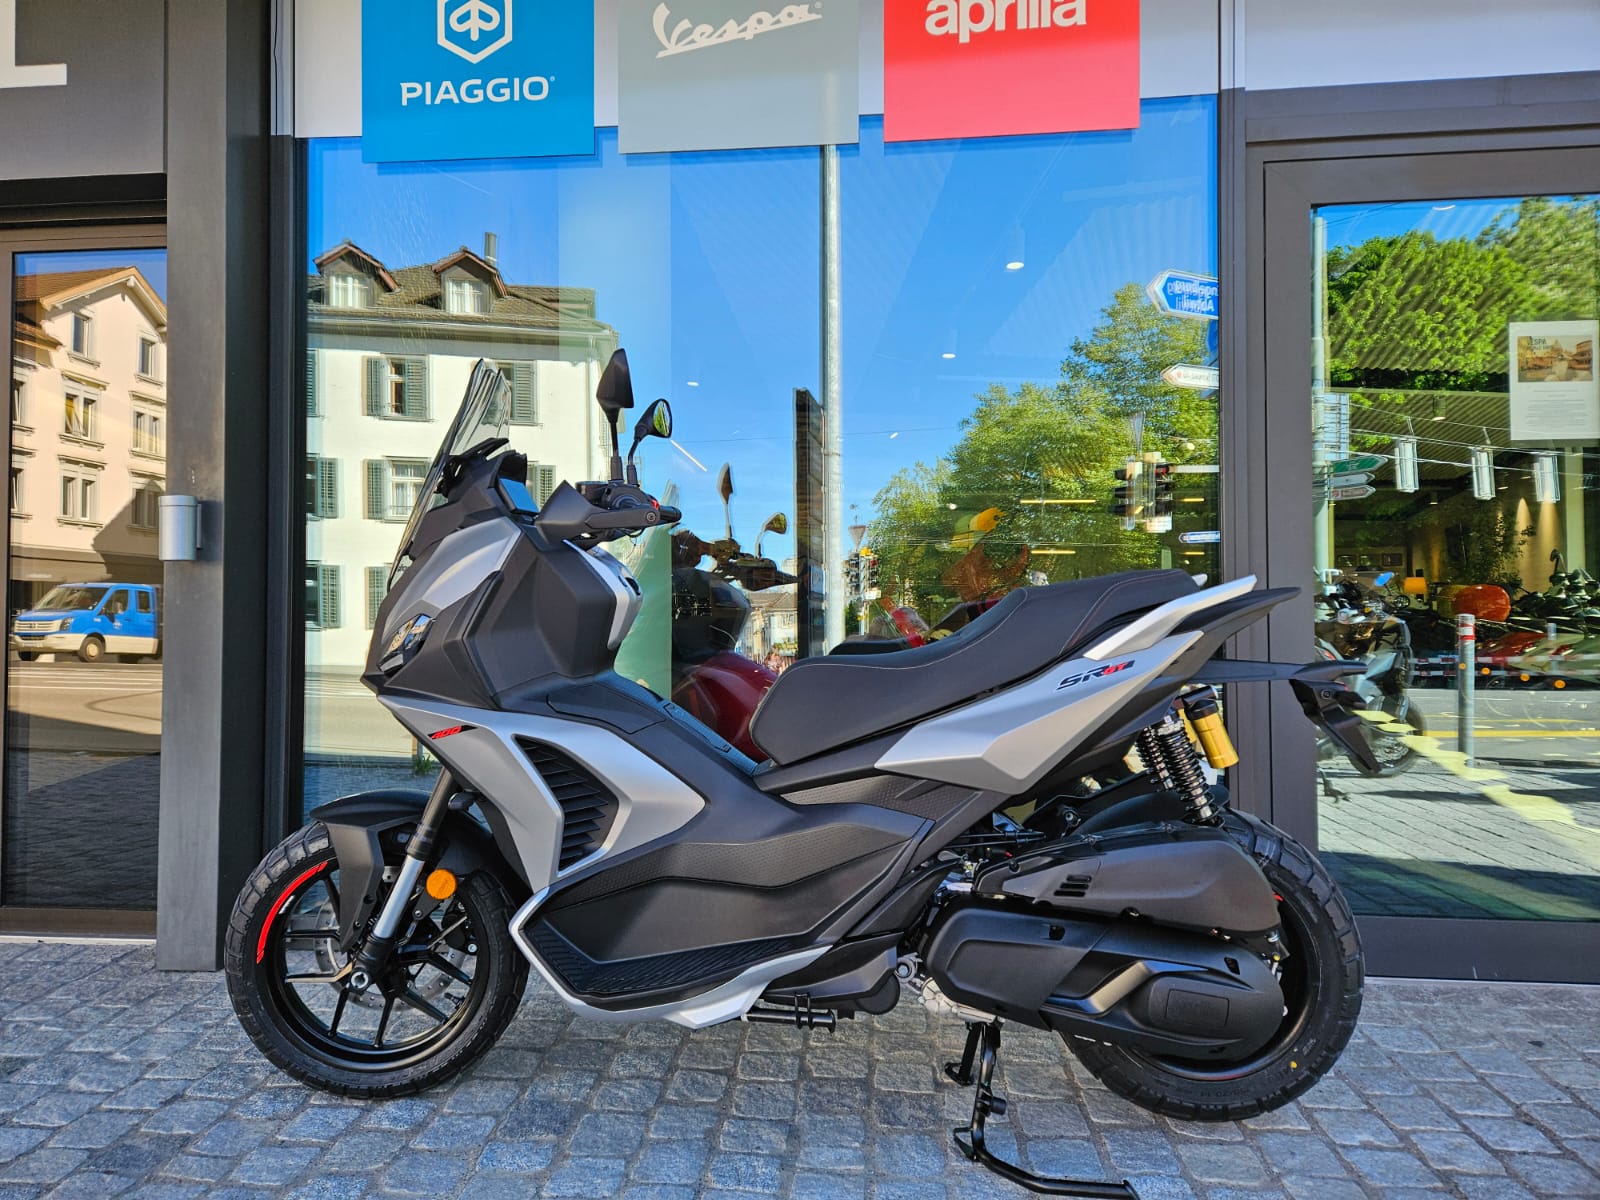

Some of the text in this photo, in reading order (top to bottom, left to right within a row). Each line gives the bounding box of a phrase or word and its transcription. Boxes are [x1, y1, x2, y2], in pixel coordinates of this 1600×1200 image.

[652, 2, 823, 59] Vespa
[925, 0, 1087, 43] aprilia
[400, 76, 549, 106] PIAGGIO
[431, 725, 463, 739] 400
